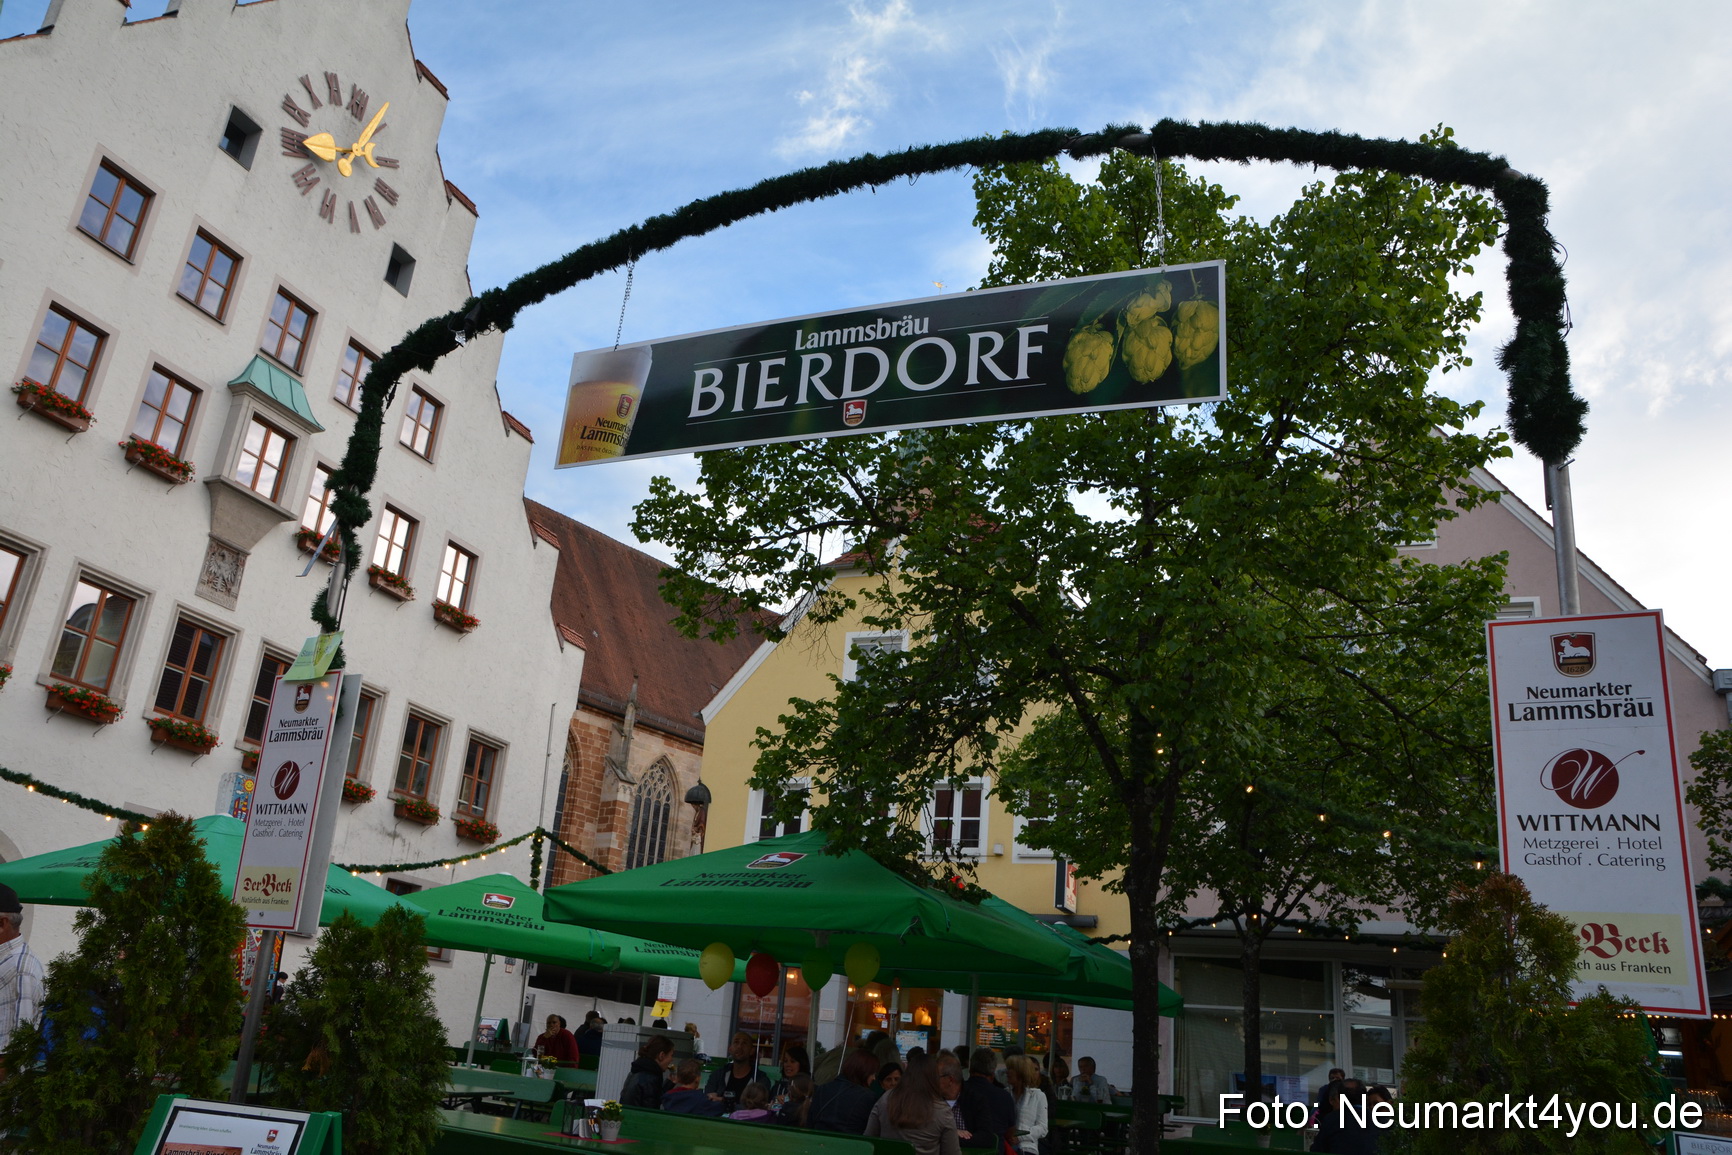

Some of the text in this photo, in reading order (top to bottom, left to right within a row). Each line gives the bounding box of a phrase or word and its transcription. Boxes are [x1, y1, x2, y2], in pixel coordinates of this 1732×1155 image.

[795, 315, 930, 351] Lammsbräu
[687, 324, 1050, 419] BIERDORF
[595, 417, 632, 435] Neumark
[580, 425, 629, 449] Lammsb
[1566, 665, 1585, 673] 1628
[1526, 682, 1633, 700] Neumarkter
[1508, 698, 1655, 722] Lammsbräu
[278, 717, 320, 729] Neumarkter
[268, 727, 324, 743] Lammsbräu
[255, 802, 309, 815] WITTMANN
[253, 818, 305, 832] Metzgerei Hotel
[1516, 813, 1661, 832] WITTMANN
[252, 828, 304, 840] Gasthof Catering
[1523, 836, 1662, 853] Metzgerei Hotel
[1524, 853, 1666, 870] Gasthof Catering
[658, 878, 815, 889] Lammsbräu
[694, 872, 808, 880] Neumarkter
[270, 897, 290, 905] Franken
[437, 909, 546, 932] Lammsbräu
[455, 906, 534, 922] Neumarkter
[634, 946, 700, 958] Lammsbr
[1595, 963, 1617, 972] aus
[1621, 961, 1672, 974] Franken
[1691, 1142, 1732, 1155] BIERDOR
